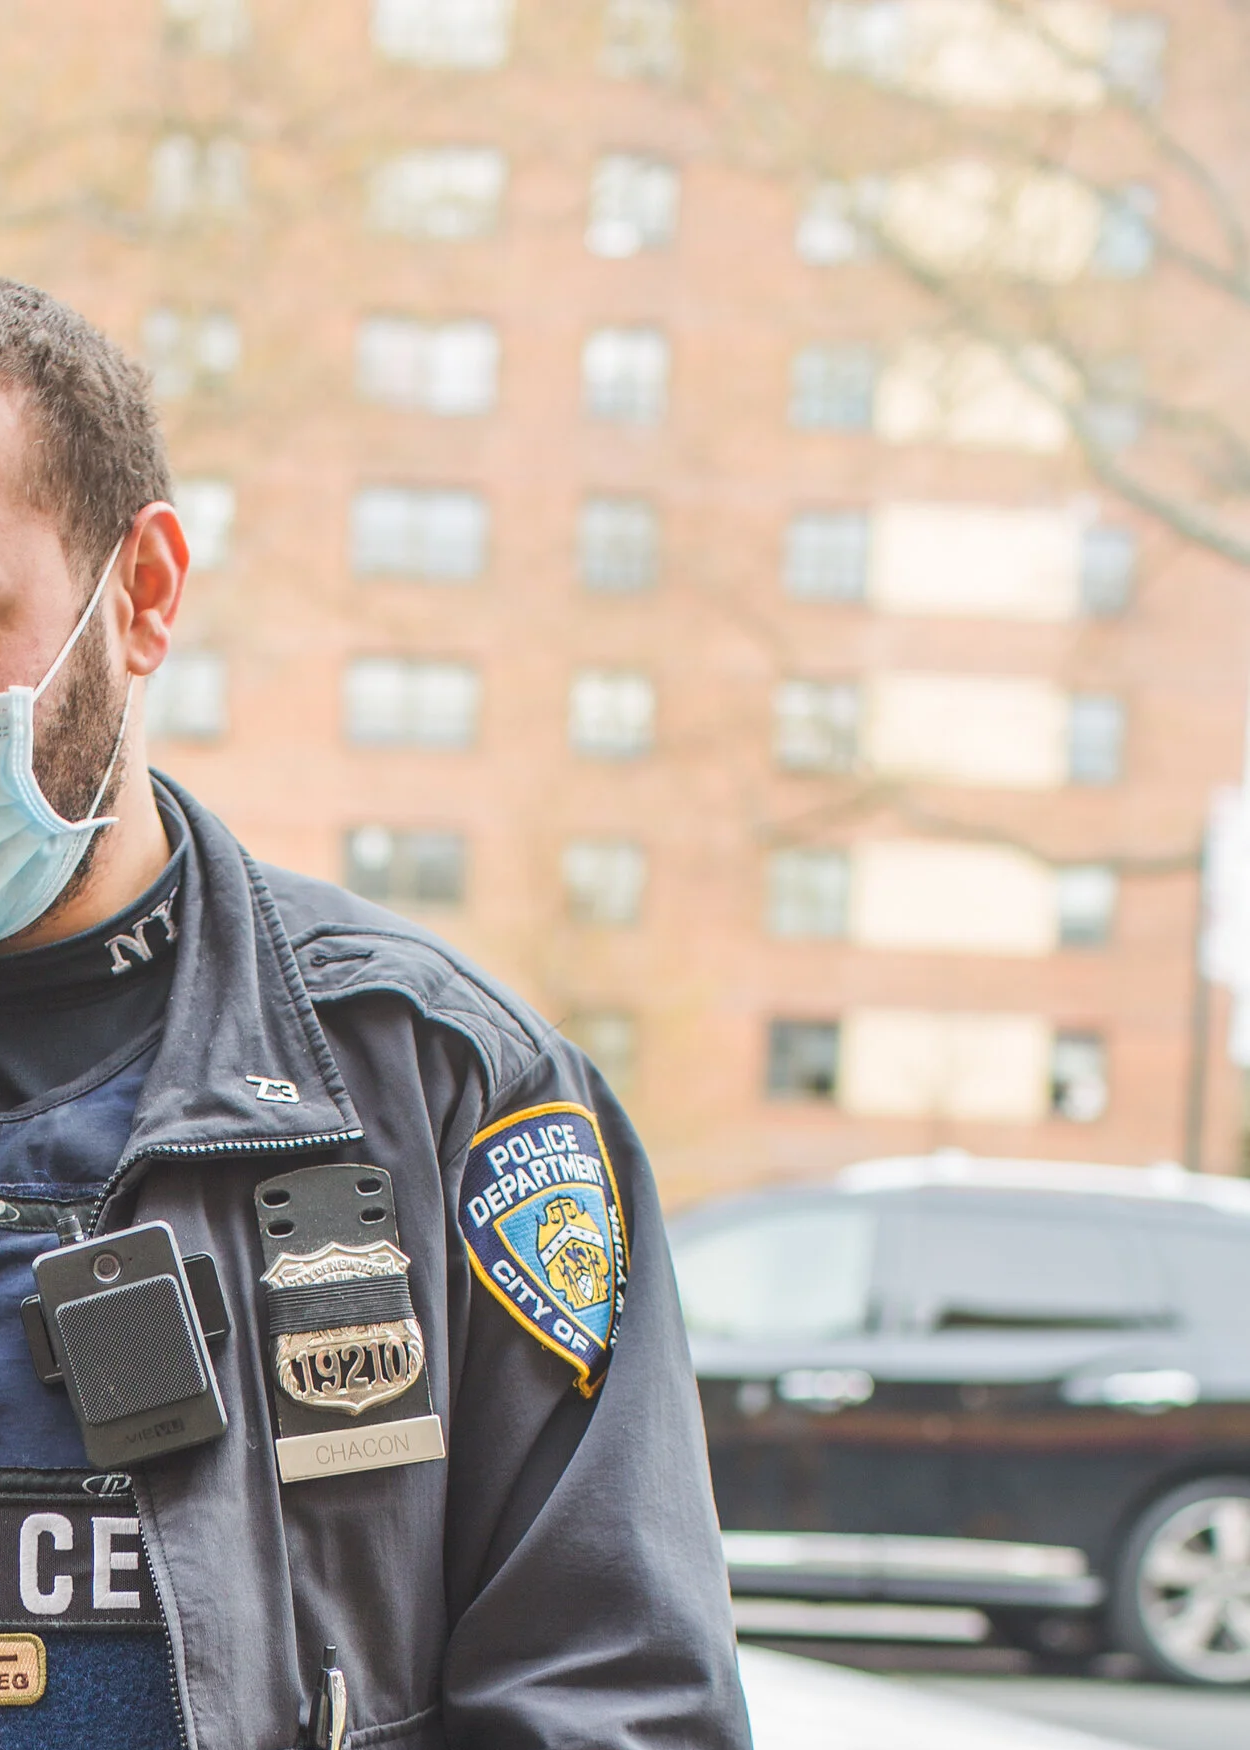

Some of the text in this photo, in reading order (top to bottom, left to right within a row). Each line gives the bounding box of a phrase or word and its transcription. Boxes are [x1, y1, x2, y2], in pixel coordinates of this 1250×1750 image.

[485, 1124, 581, 1176] POLICE
[466, 1153, 606, 1229] DEPARTMENT
[607, 1204, 629, 1286] YORK
[491, 1259, 590, 1353] CITY OF
[296, 1335, 408, 1399] 19210
[315, 1432, 410, 1465] CHACON
